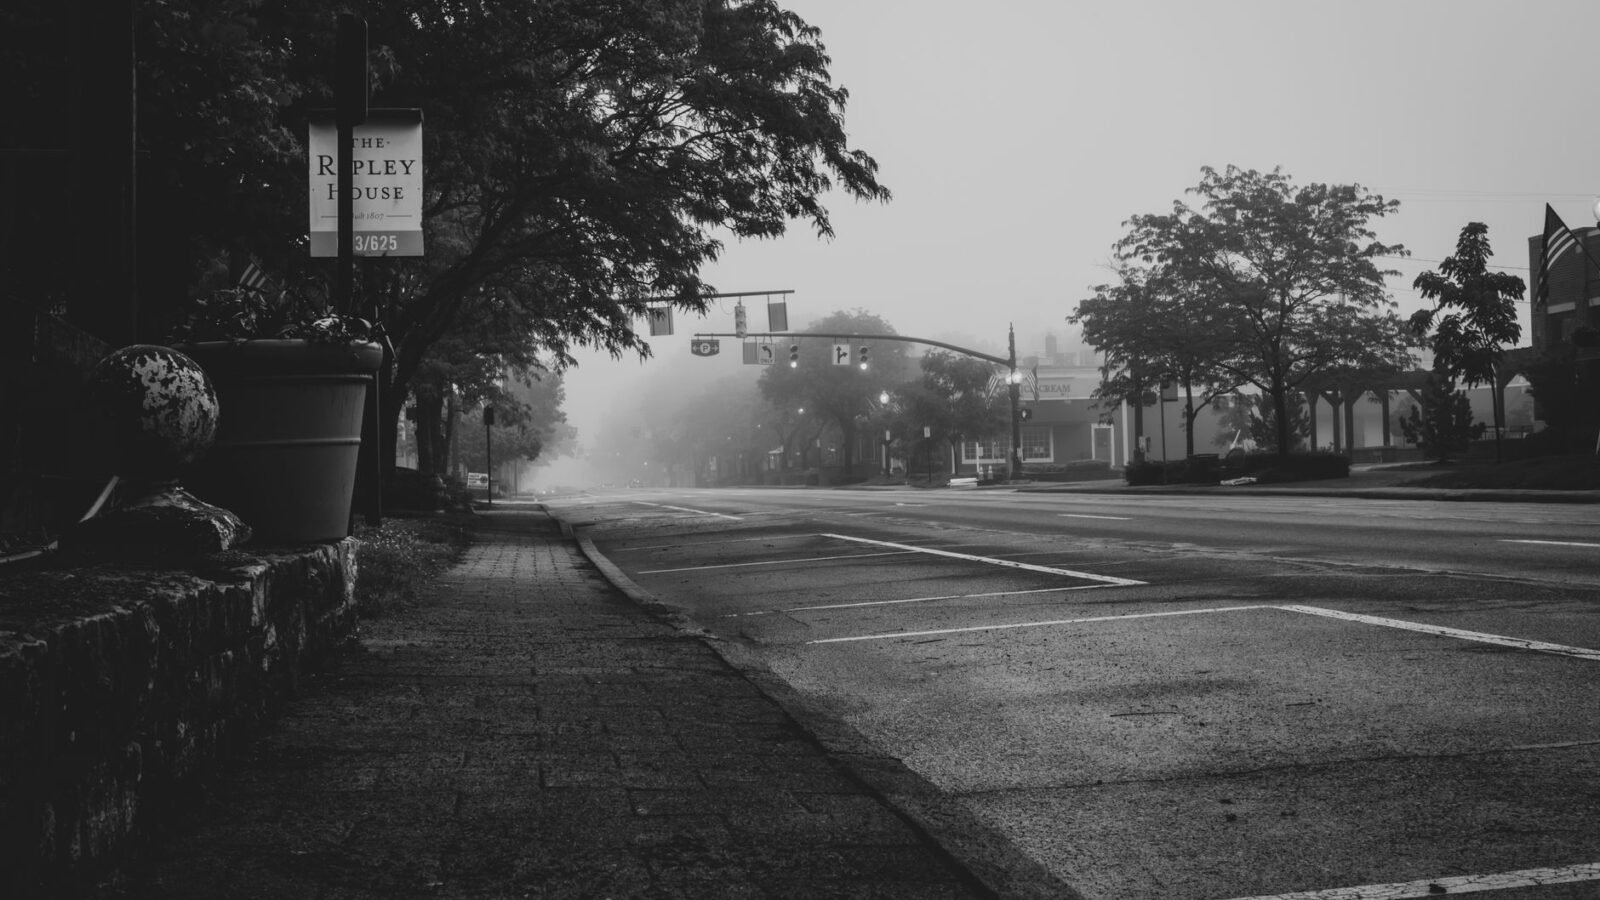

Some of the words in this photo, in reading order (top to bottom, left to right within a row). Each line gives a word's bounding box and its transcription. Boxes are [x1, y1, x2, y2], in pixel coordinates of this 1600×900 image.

[317, 155, 415, 175] RPLEY
[367, 212, 384, 221] 1807
[1038, 384, 1070, 392] CREAM
